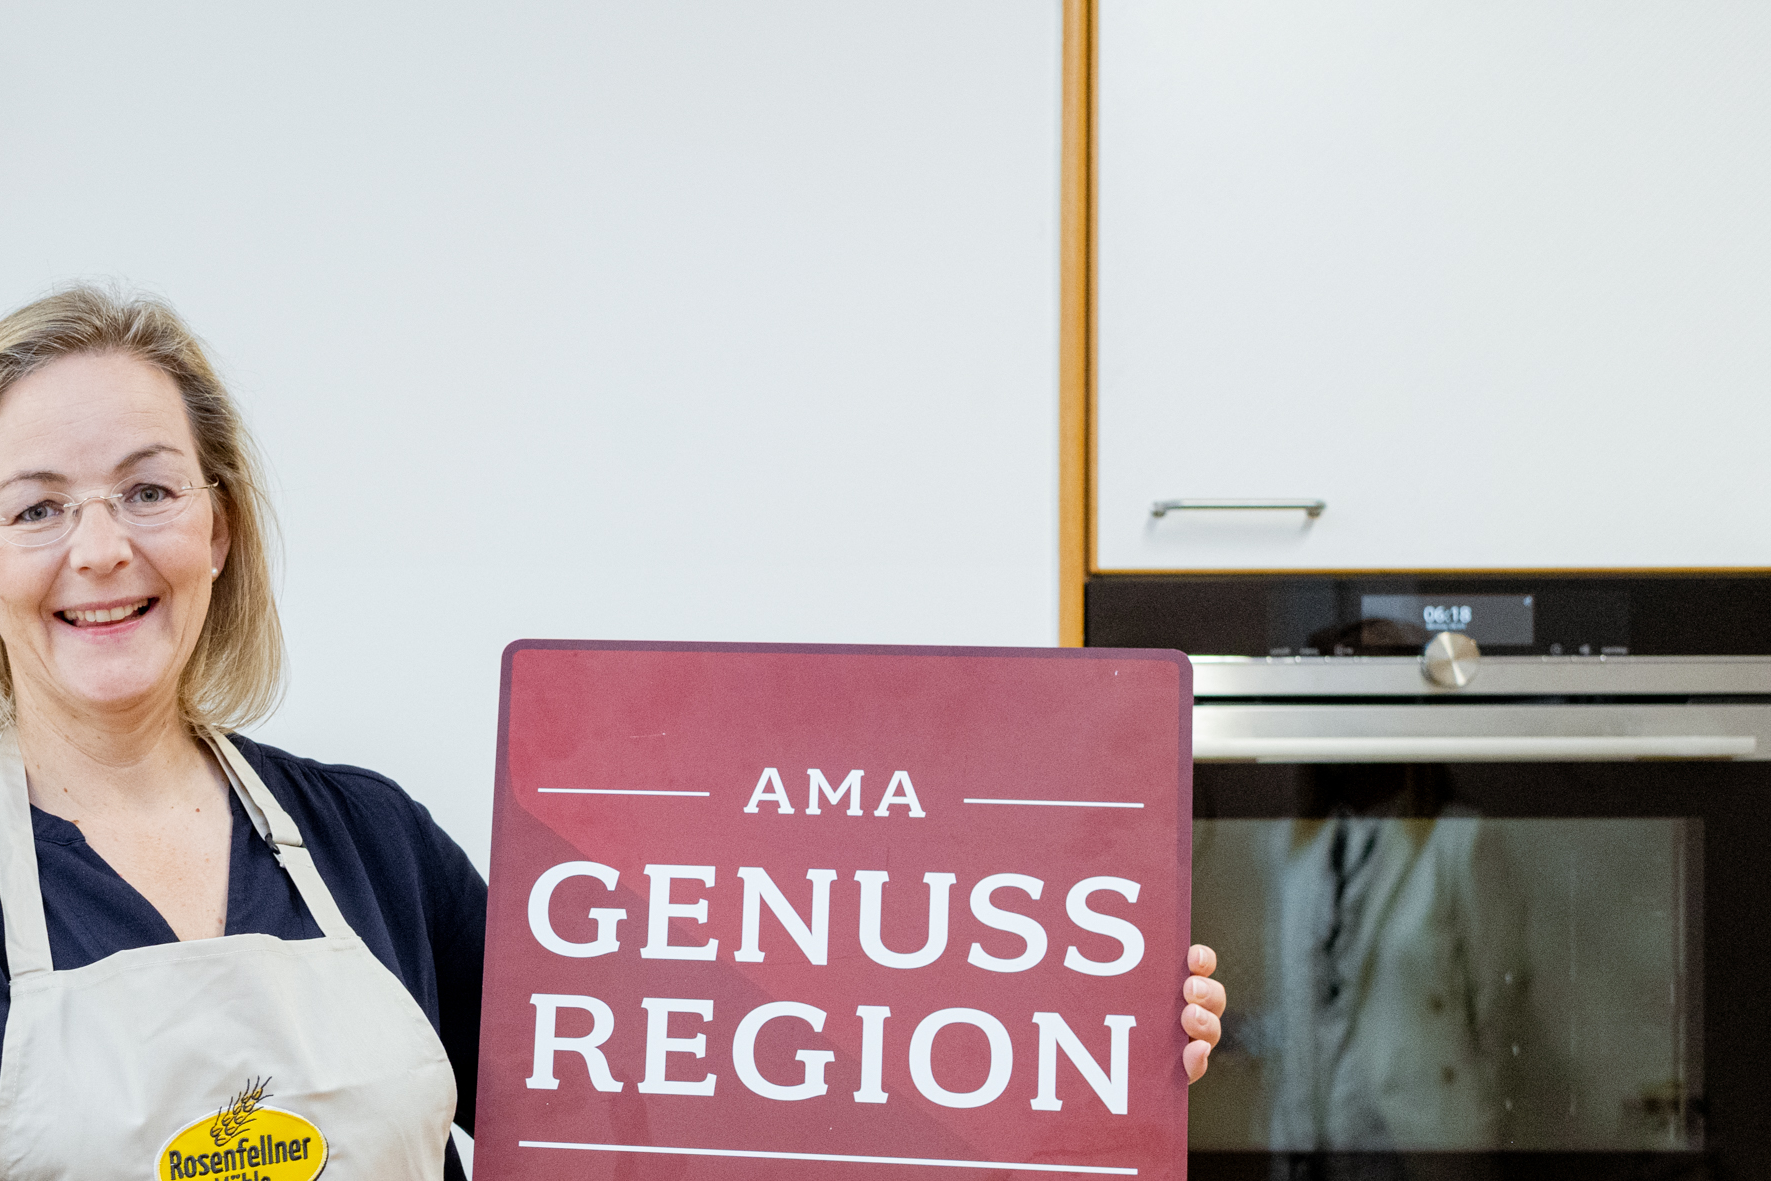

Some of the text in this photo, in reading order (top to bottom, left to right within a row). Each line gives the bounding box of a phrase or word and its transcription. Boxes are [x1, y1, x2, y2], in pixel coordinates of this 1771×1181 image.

[1423, 605, 1472, 624] 06:18
[743, 767, 926, 818] AMA
[527, 860, 1146, 977] GENUSS
[525, 992, 1138, 1115] REGION
[169, 1134, 311, 1181] Rosenfellner
